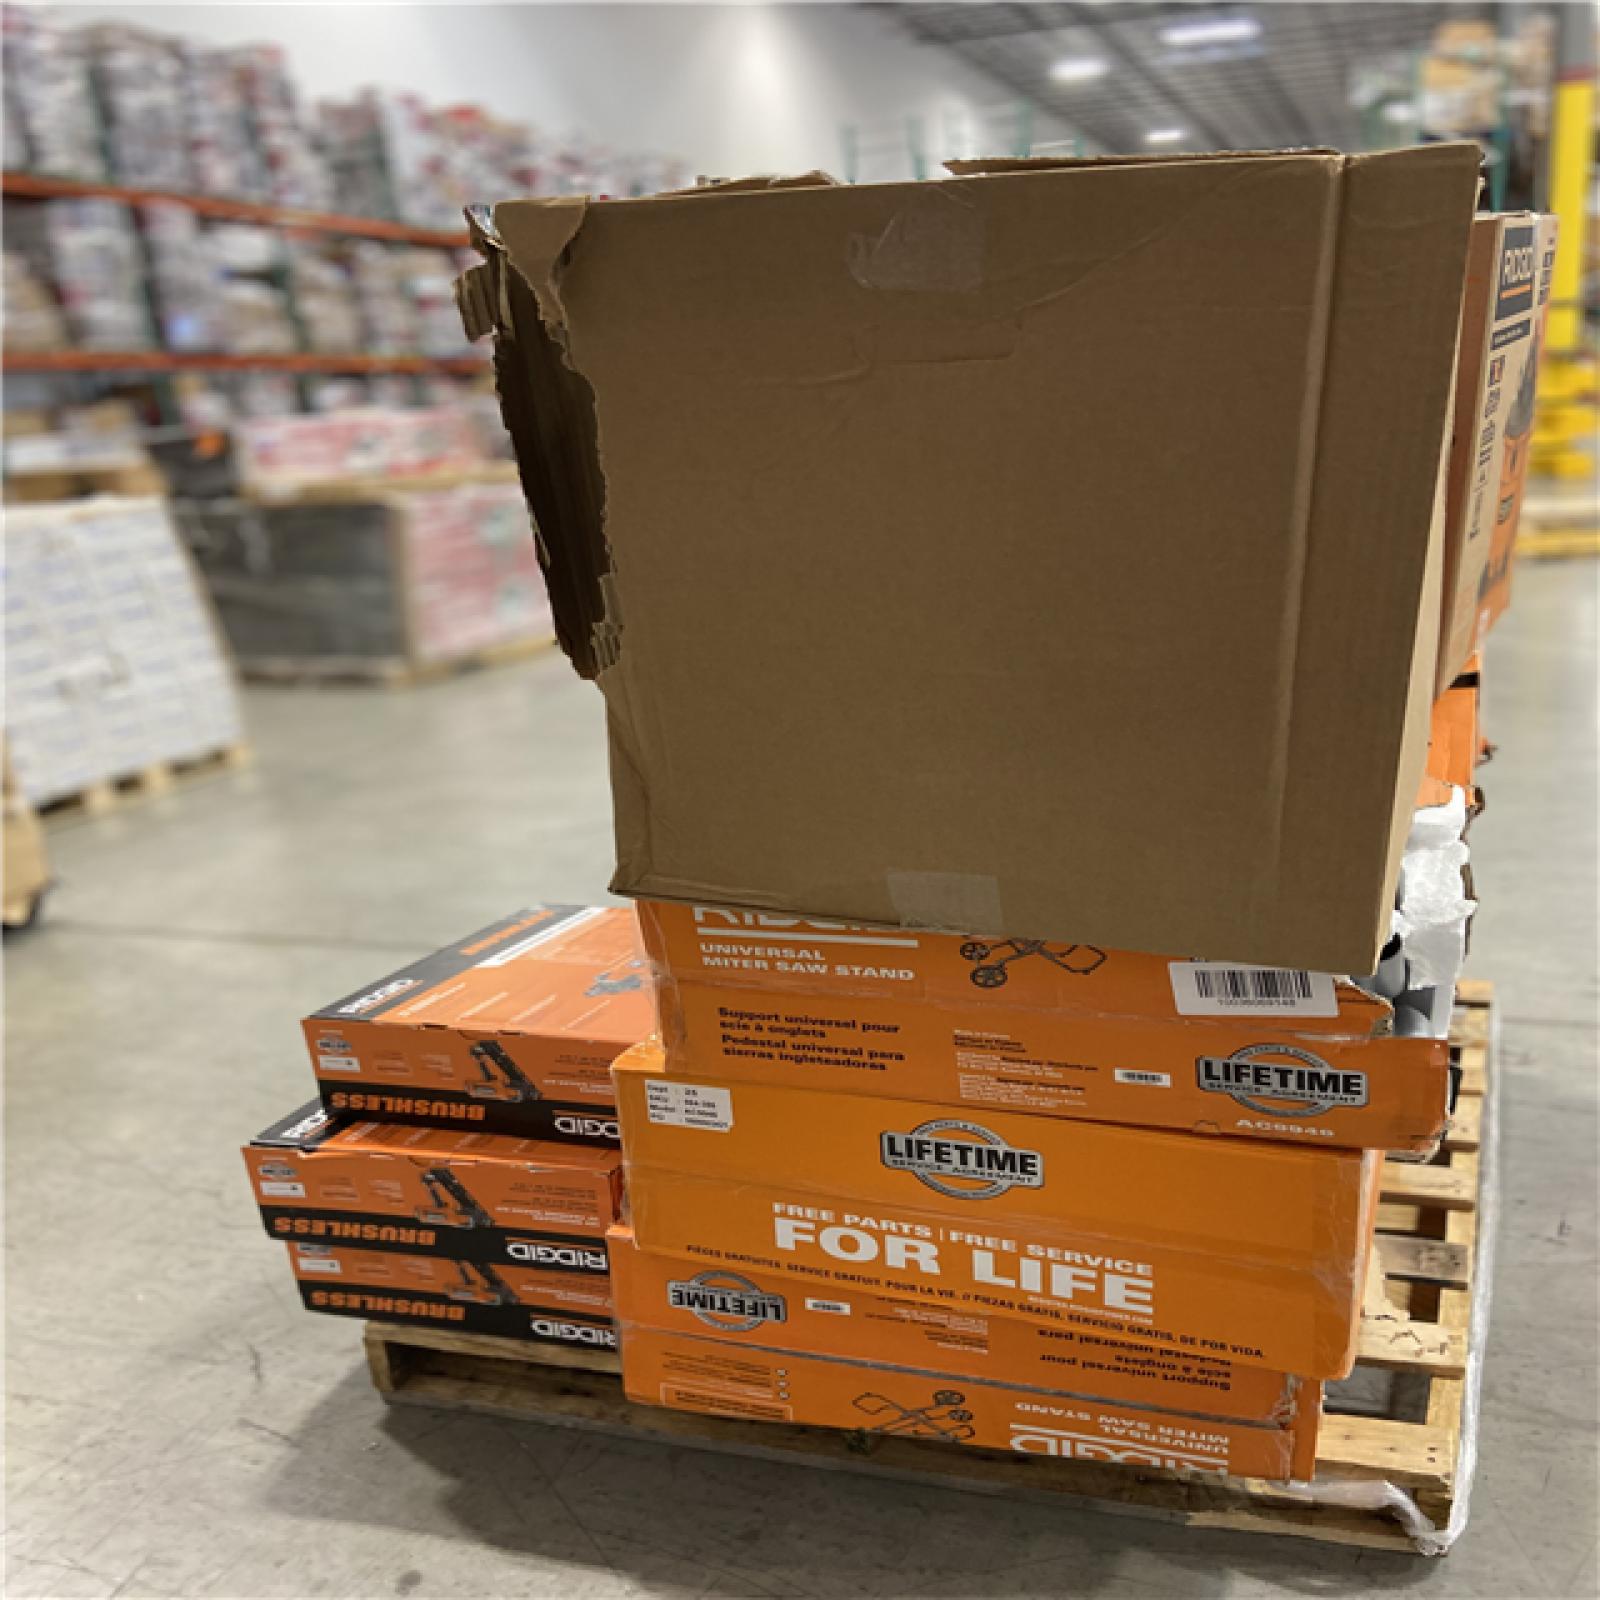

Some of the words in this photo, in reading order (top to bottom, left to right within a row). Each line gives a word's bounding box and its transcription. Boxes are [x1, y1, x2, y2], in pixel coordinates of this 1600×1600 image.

[700, 943, 825, 961] UNIVERSAL
[703, 957, 769, 971] MITER
[776, 961, 828, 974] SAW
[835, 964, 914, 981] STAND
[718, 1007, 780, 1022] Support
[784, 1015, 856, 1029] universal
[862, 1022, 900, 1034] pour
[768, 1026, 826, 1039] onglets
[722, 1034, 786, 1049] Pedestal
[792, 1042, 863, 1056] universal
[868, 1050, 905, 1062] para
[723, 1047, 774, 1060] sierras
[1204, 1060, 1361, 1096] LIFETIME
[331, 1092, 485, 1121] BRUSHLESS
[554, 1116, 620, 1138] DGID
[887, 1134, 1039, 1176] LIFETIME
[275, 1217, 435, 1246] BRUSHLESS
[772, 1202, 835, 1223] FREE
[844, 1214, 933, 1239] PARTS
[949, 1230, 1017, 1253] FREE
[1027, 1244, 1153, 1275] SERVICE
[507, 1243, 608, 1270] RIDGID
[774, 1216, 941, 1276] FOR
[972, 1249, 1153, 1315] LIFE
[311, 1290, 465, 1320] BRUSHLESS
[672, 1289, 781, 1321] LIFETIME
[1039, 1354, 1077, 1366] pour
[1081, 1360, 1157, 1378] universal
[1162, 1374, 1231, 1391] Support
[1015, 1402, 1091, 1421] STAND
[1098, 1414, 1151, 1431] SAW
[1100, 1425, 1229, 1454] UNIVERSAL
[1158, 1425, 1229, 1444] MITER
